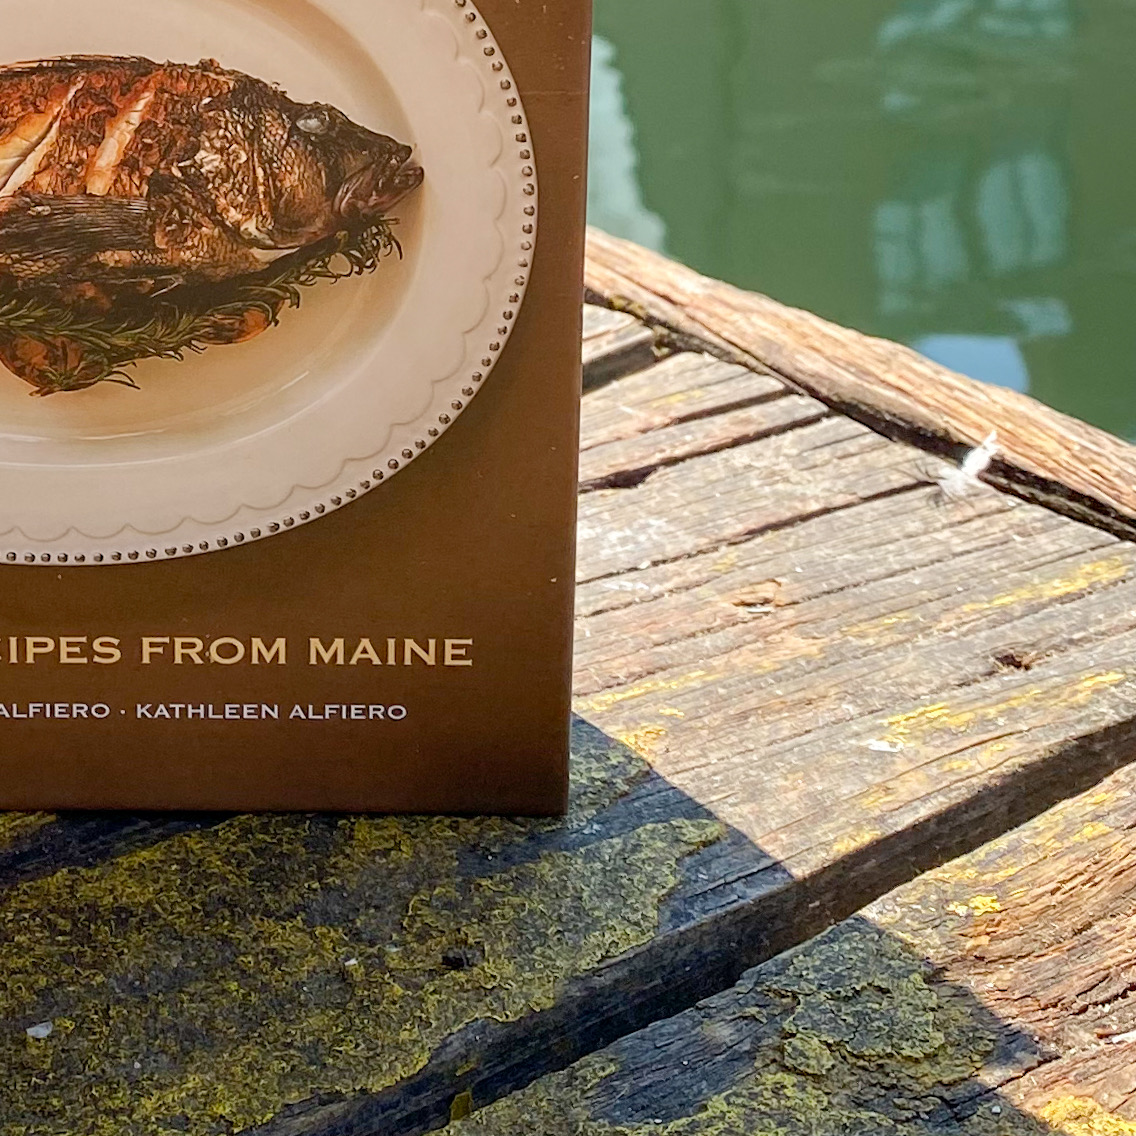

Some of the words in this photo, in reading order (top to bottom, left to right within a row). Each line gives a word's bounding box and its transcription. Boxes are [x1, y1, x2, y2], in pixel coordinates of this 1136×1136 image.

[141, 636, 287, 666] FROM
[309, 637, 474, 667] MAINE
[136, 703, 279, 720] KATHLEEN
[289, 704, 408, 721] ALFIERO
